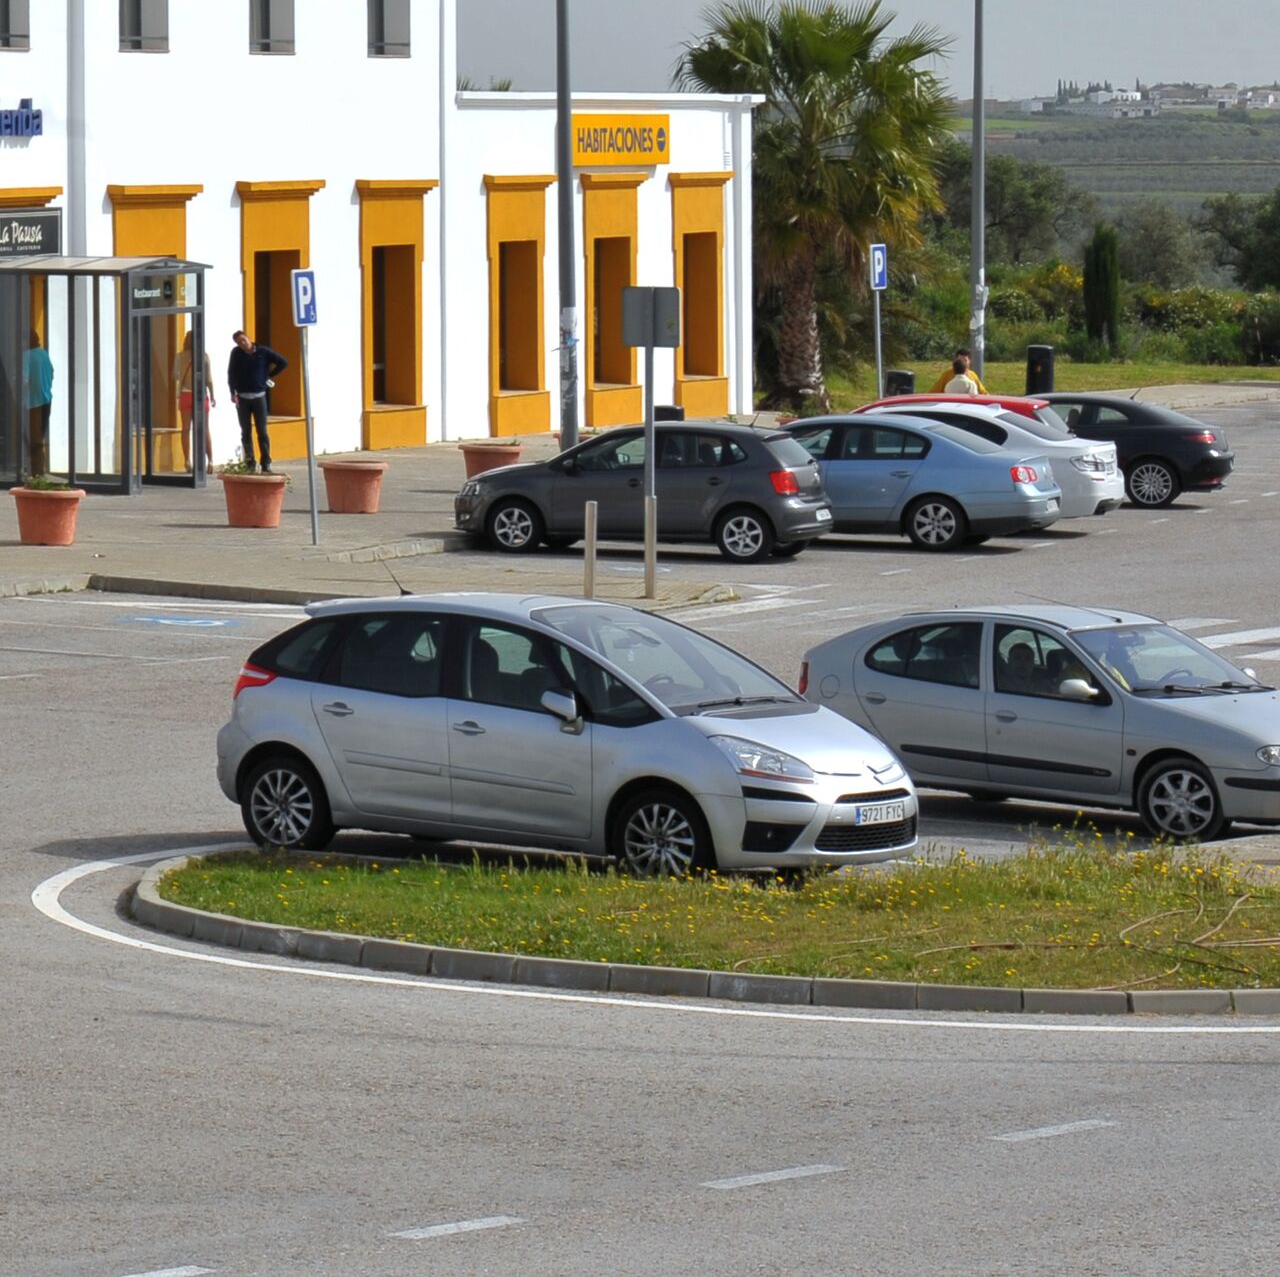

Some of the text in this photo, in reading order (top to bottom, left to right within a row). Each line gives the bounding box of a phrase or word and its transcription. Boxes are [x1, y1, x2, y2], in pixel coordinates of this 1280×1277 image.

[577, 126, 654, 153] HABITACIONES
[11, 220, 42, 245] Pausa
[874, 250, 884, 284] P
[297, 276, 312, 319] P
[861, 805, 902, 823] 9721 FYC
